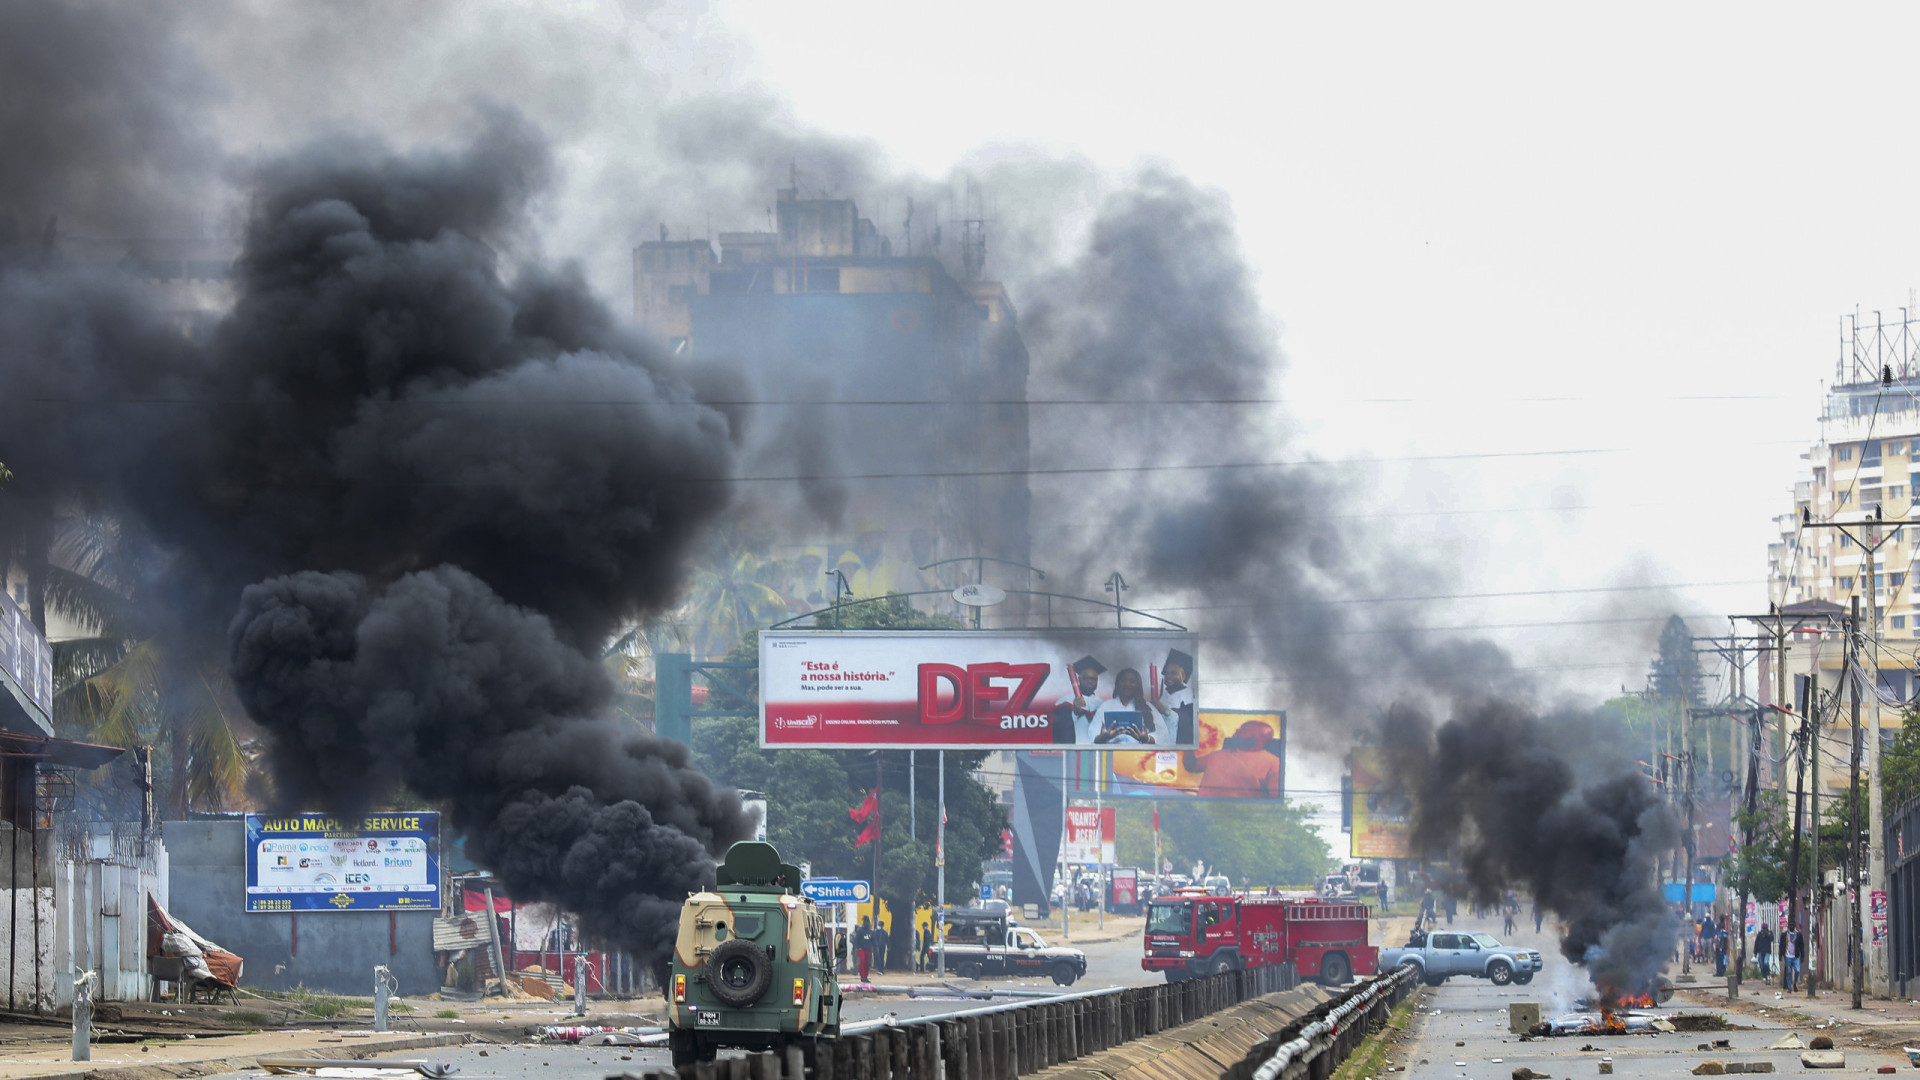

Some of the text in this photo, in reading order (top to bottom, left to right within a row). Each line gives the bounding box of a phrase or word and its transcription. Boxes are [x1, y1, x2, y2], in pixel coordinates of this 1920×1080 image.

[832, 660, 839, 671] é
[801, 673, 807, 681] a
[810, 673, 841, 681] nossa
[817, 684, 834, 692] pode
[918, 662, 1050, 727] DEZ
[1000, 714, 1049, 729] anos
[264, 818, 300, 831] AUTO
[364, 817, 419, 830] SERVICE
[384, 857, 413, 866] Britam
[817, 886, 852, 897] Shifaa
